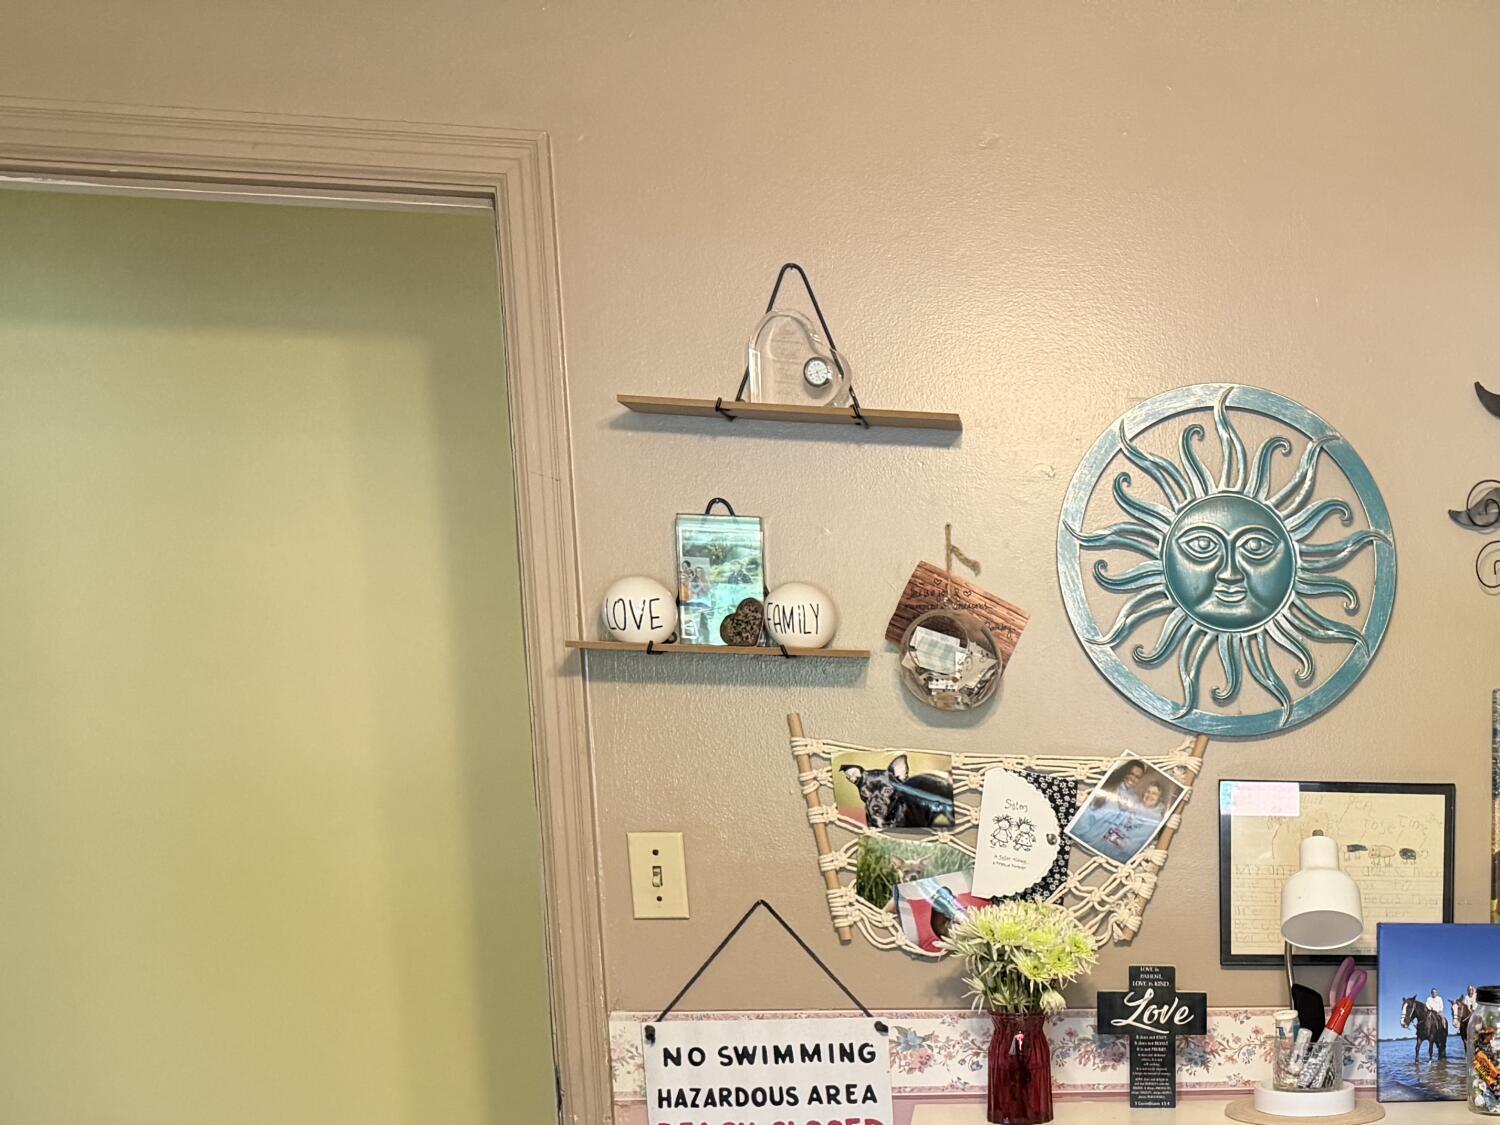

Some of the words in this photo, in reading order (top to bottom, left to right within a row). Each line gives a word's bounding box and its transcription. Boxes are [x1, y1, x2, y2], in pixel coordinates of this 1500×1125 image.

[605, 598, 663, 631] LOVE
[1111, 988, 1195, 1034] Love
[663, 1046, 706, 1067] NO
[719, 1042, 876, 1066] SWIMMING
[657, 1086, 799, 1109] HAZARDOUS
[807, 1084, 878, 1105] AREA
